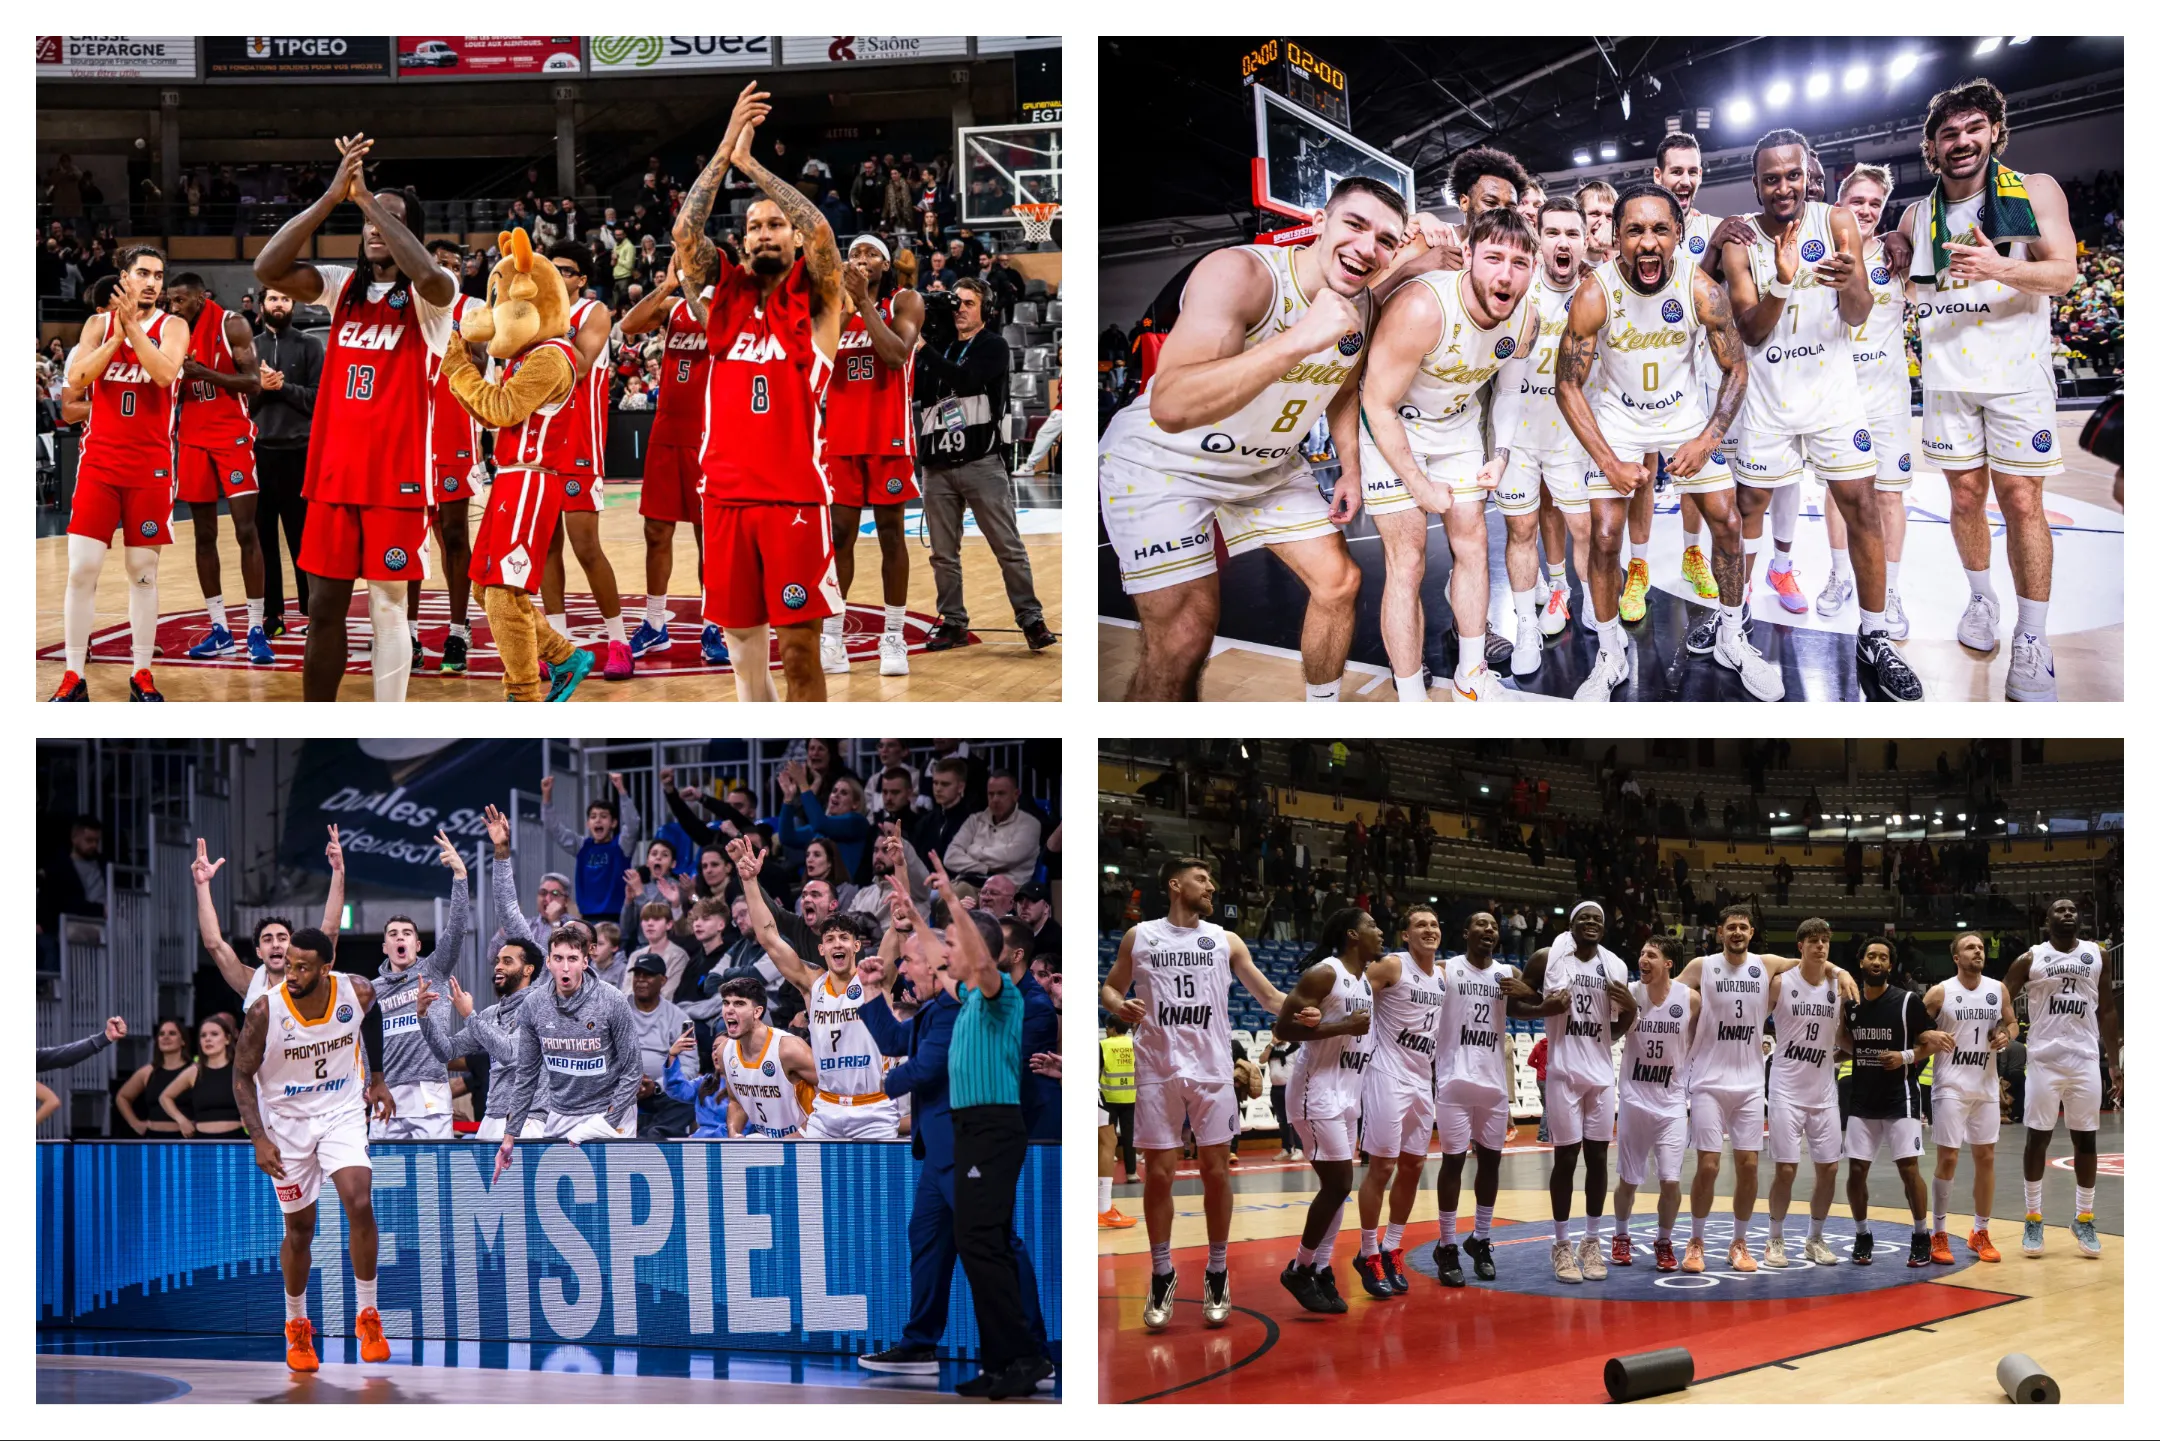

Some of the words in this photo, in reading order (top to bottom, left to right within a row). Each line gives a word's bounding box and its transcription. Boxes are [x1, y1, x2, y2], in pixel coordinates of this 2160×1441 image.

[69, 44, 166, 56] D'EPARGNE
[274, 38, 348, 56] TPGEO
[867, 36, 920, 52] Saône
[550, 60, 567, 69] ada
[1787, 303, 1799, 335] 7
[1935, 303, 1991, 315] VEOLIA
[338, 321, 406, 350] ELAN
[1606, 325, 1688, 353] Levice
[1783, 343, 1826, 361] VEOLIA
[677, 359, 691, 383] 5
[847, 355, 875, 381] 25
[1275, 360, 1352, 386] evice
[1642, 361, 1659, 392] 0
[192, 380, 217, 403] 40
[345, 364, 376, 401] 13
[121, 391, 137, 417] 0
[751, 374, 770, 414] 8
[1444, 393, 1471, 415] 3
[1636, 390, 1684, 411] VEOLIA
[1270, 399, 1308, 433] 8
[938, 430, 966, 453] 49
[1494, 490, 1526, 500] ALEON
[1134, 532, 1210, 560] HALEON
[1227, 907, 1235, 916] A
[1150, 950, 1214, 968] WÜRZBURG
[2045, 963, 2091, 978] WÜRZBURG
[1173, 974, 1195, 999] 15
[1716, 978, 1760, 994] WÜRZBURG
[2061, 977, 2077, 994] 27
[1474, 1003, 1490, 1024] 22
[1576, 993, 1593, 1015] 32
[1735, 999, 1743, 1018] 3
[1791, 1001, 1835, 1019] WÜRZBURG
[1954, 1006, 1998, 1021] WÜRZBURG
[1423, 1012, 1435, 1032] 11
[1806, 1022, 1820, 1041] 19
[542, 1037, 602, 1051] PROMITHERS
[830, 1030, 842, 1053] 7
[1974, 1026, 1979, 1045] 1
[284, 1032, 354, 1060] PROMITHERS
[1646, 1039, 1664, 1059] 35
[314, 1058, 328, 1079] 2
[547, 1056, 569, 1068] MED
[570, 1058, 604, 1071] FRIGO
[837, 1054, 871, 1069] FRIGO
[1119, 1077, 1128, 1086] 84
[755, 1102, 768, 1124] 5
